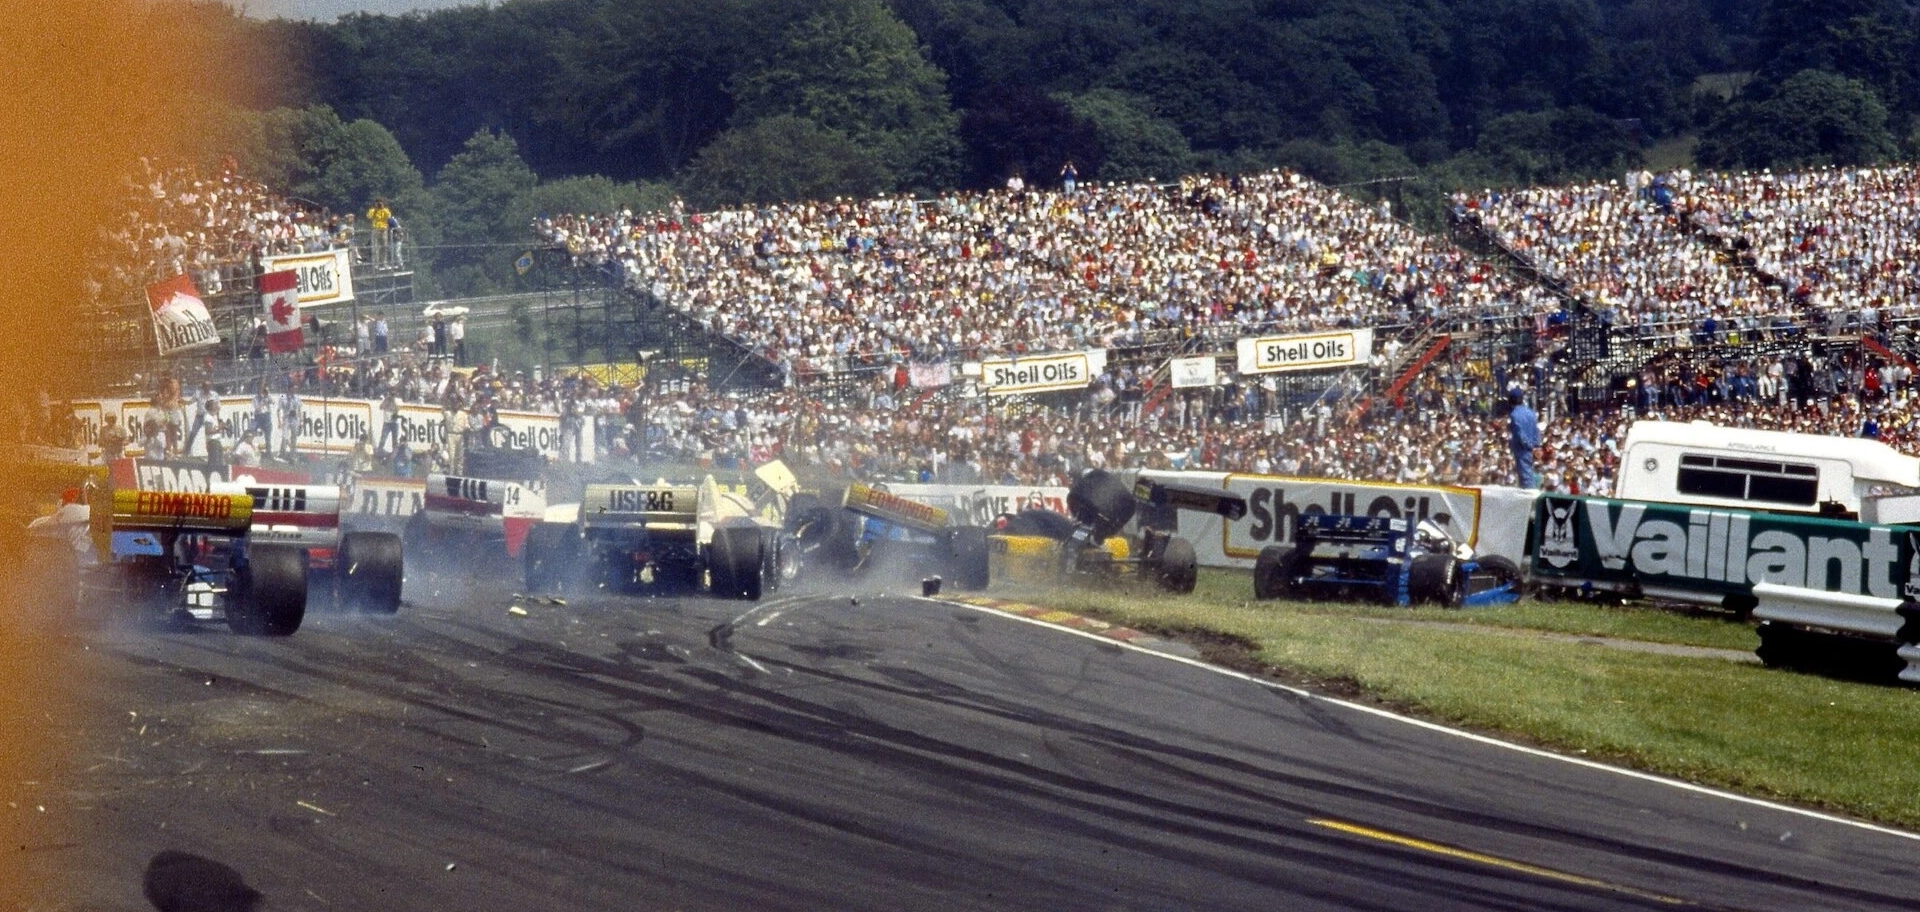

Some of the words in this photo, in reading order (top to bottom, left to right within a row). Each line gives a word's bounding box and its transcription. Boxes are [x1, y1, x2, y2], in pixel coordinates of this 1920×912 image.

[310, 265, 333, 291] Oils
[157, 309, 214, 348] Marlbo
[1267, 343, 1308, 362] Shell
[1313, 341, 1345, 359] Oils
[995, 366, 1038, 386] Shell
[1043, 363, 1077, 381] Oils
[81, 416, 98, 444] ils
[302, 411, 333, 438] hell
[336, 413, 367, 439] Oils
[509, 426, 536, 448] hell
[137, 492, 232, 518] EDMONDO
[507, 486, 521, 506] 14
[610, 490, 674, 512] USF&G
[1540, 547, 1577, 559] Vaillant
[1585, 500, 1898, 598] Vaillant
